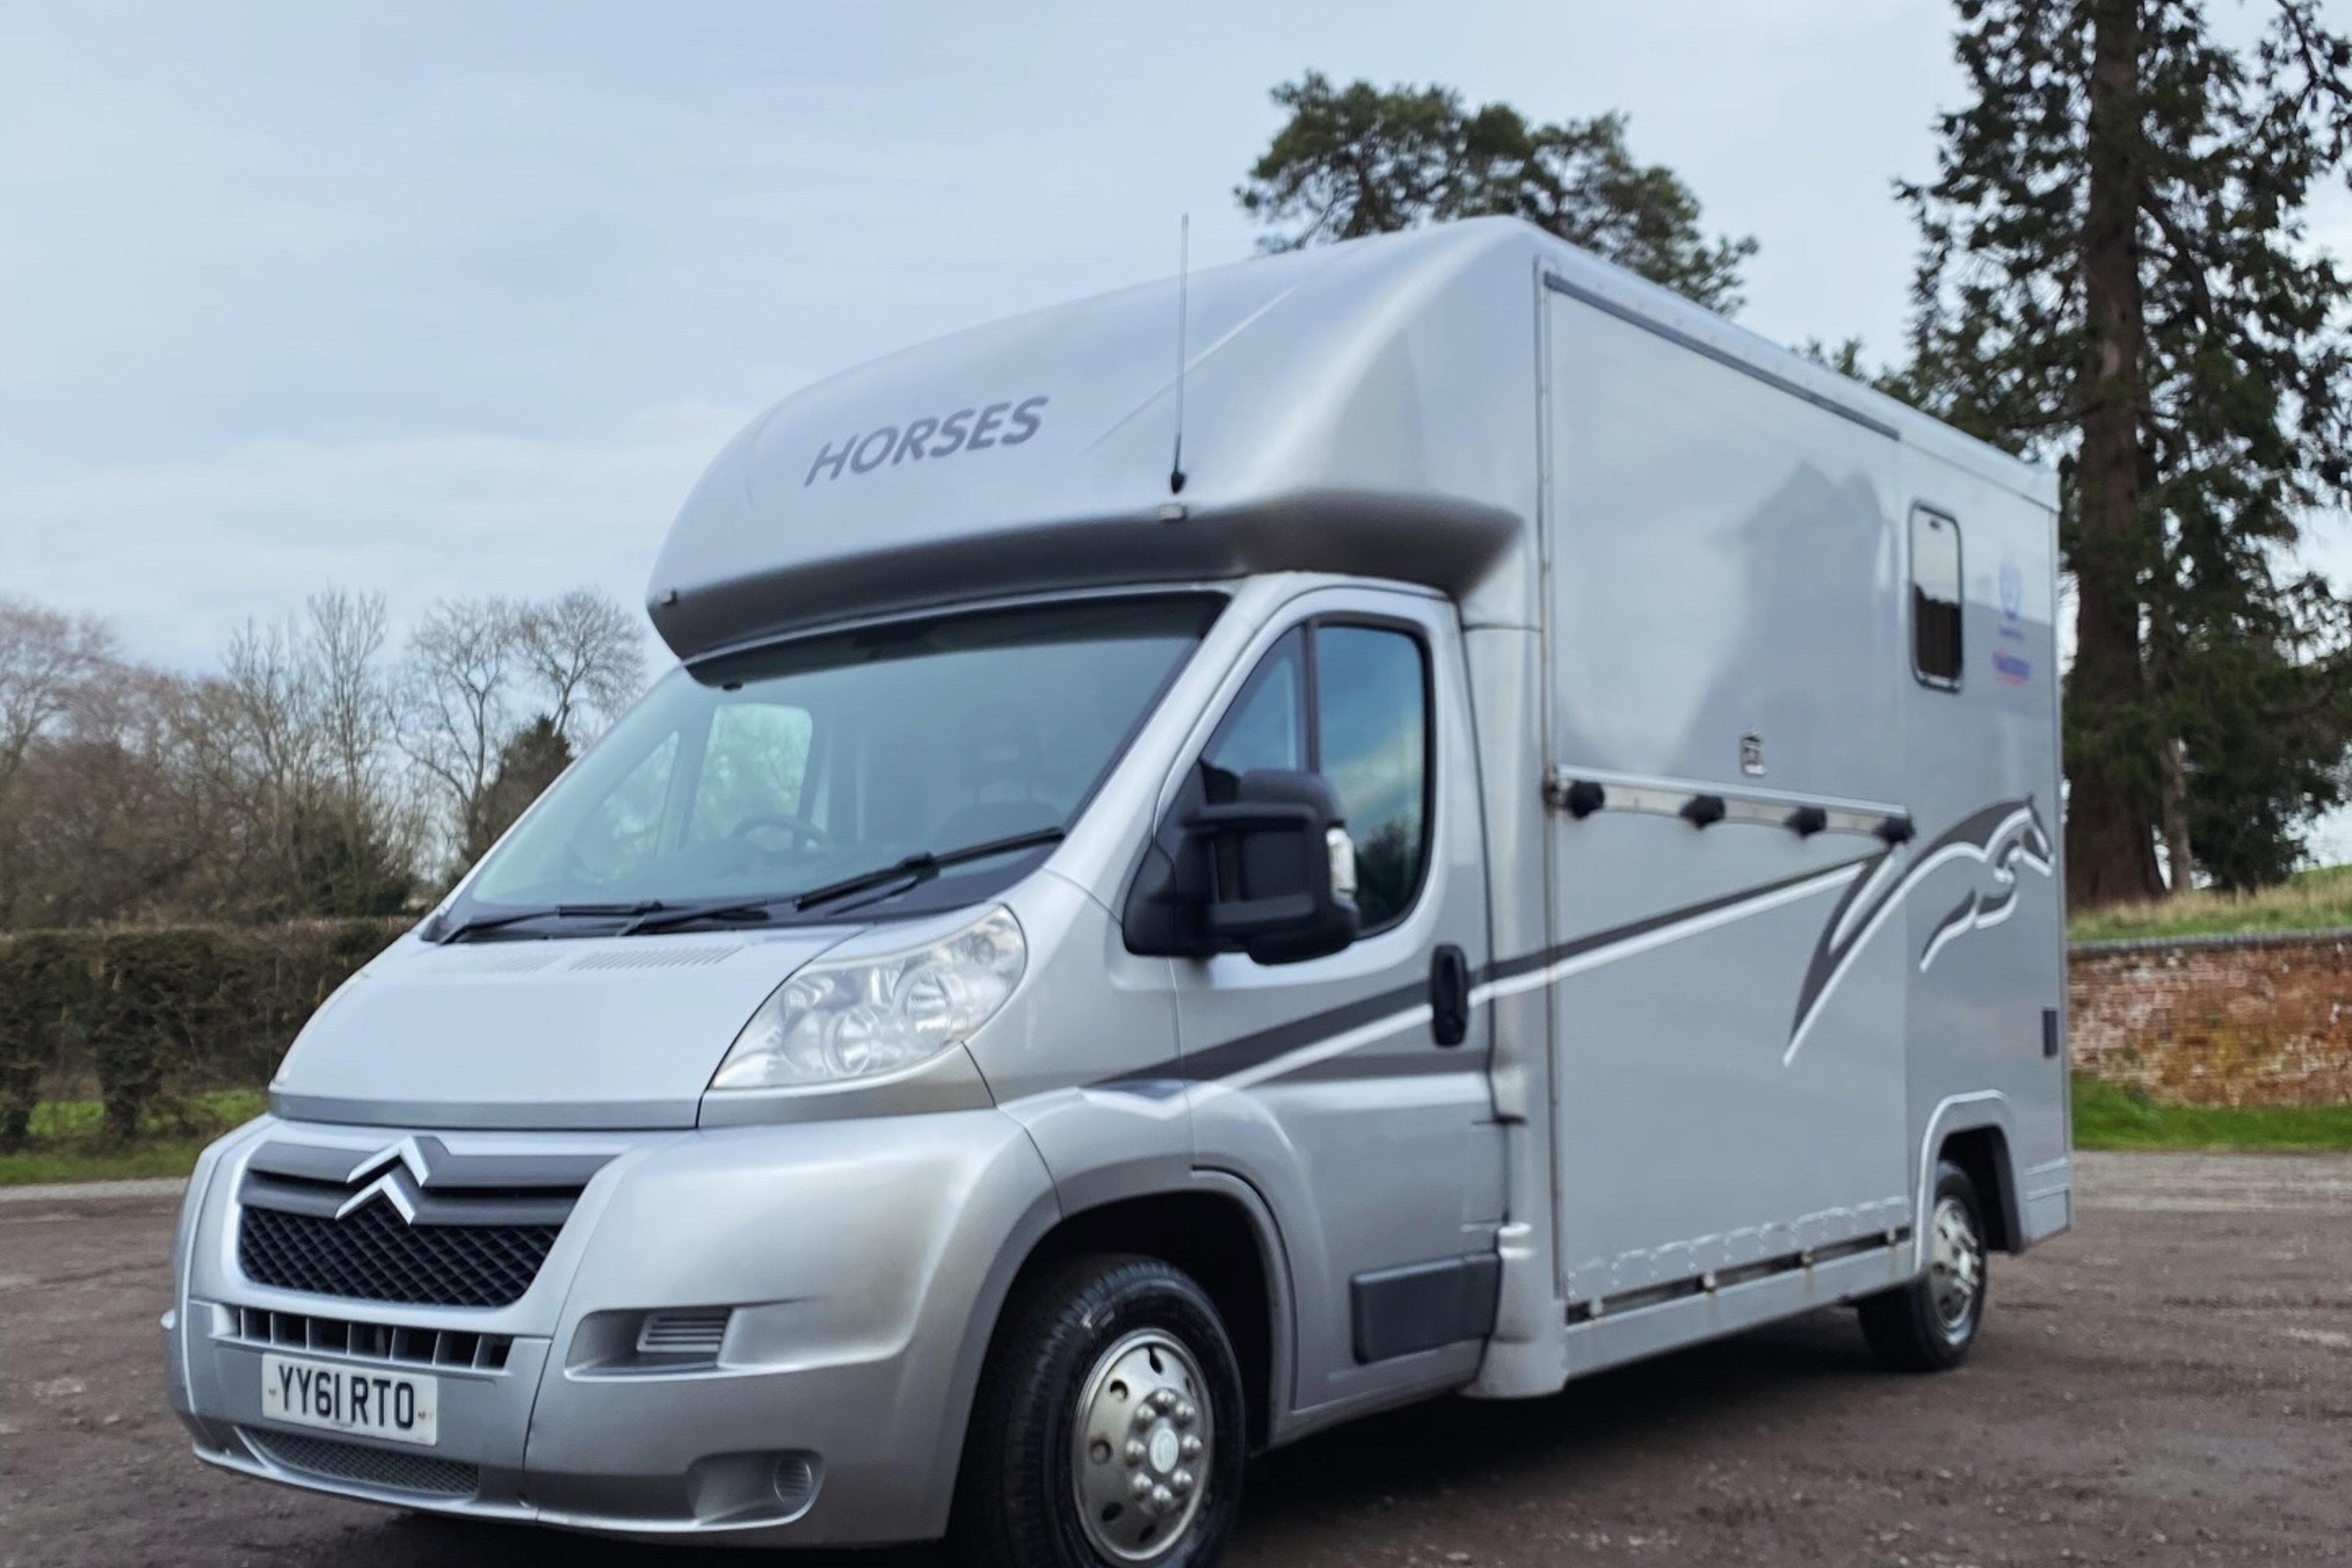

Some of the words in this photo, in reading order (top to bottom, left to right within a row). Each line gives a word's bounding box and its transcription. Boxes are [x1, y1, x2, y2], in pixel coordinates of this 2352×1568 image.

[804, 396, 1050, 488] HORSES
[279, 1365, 341, 1420] YY61
[351, 1376, 414, 1430] RTO
